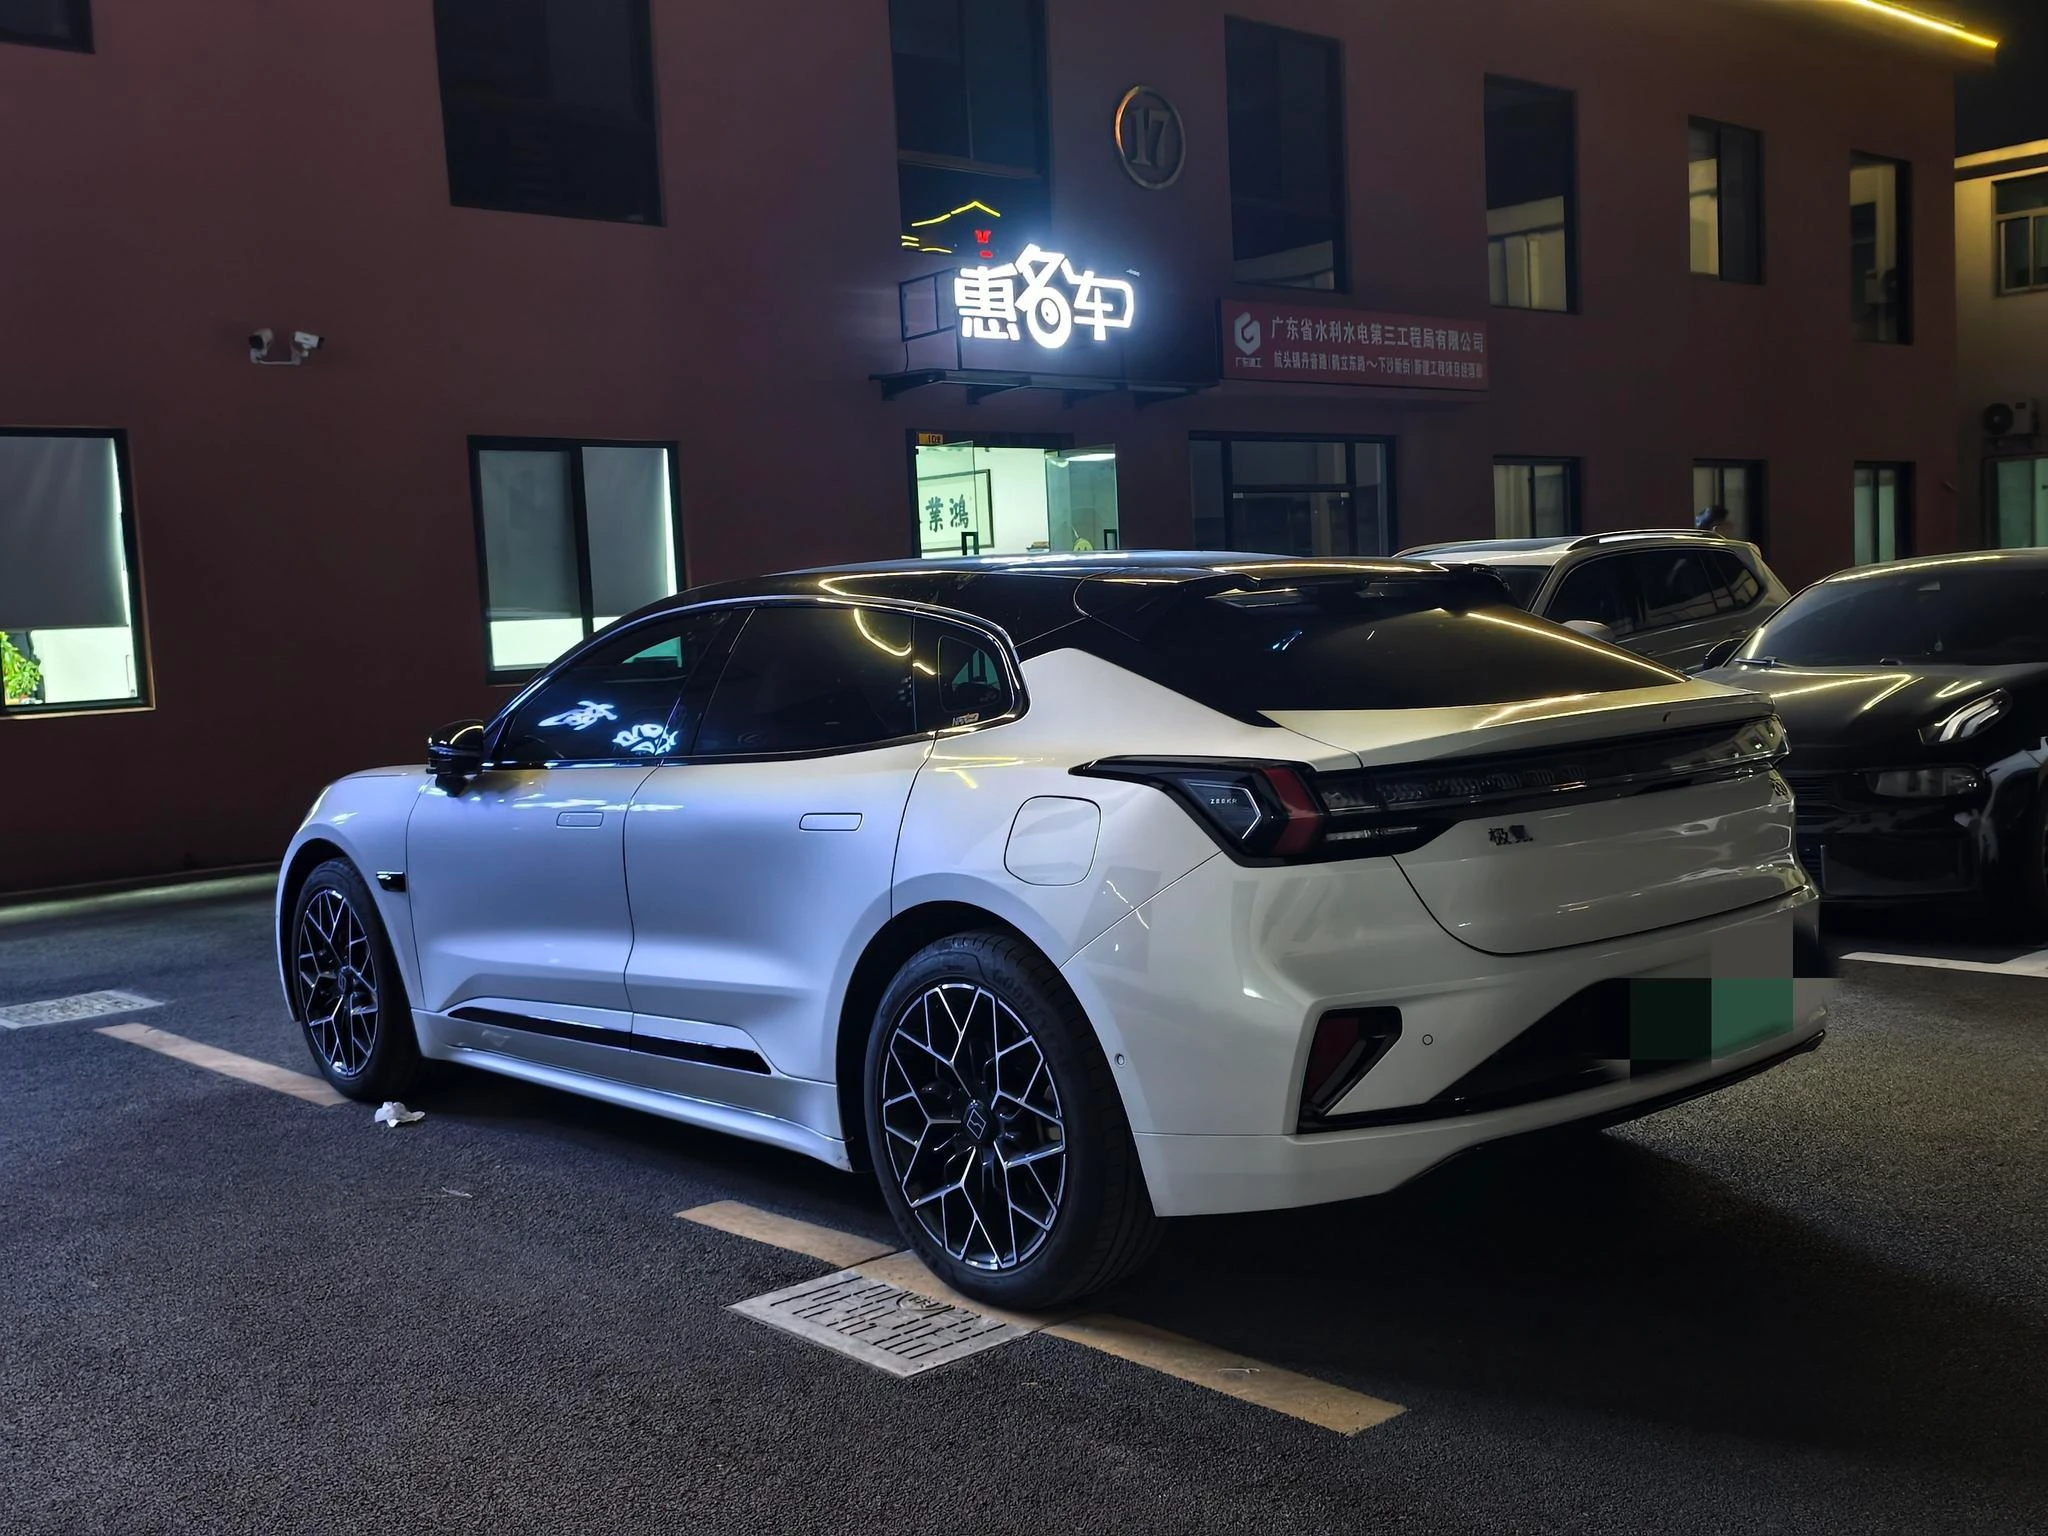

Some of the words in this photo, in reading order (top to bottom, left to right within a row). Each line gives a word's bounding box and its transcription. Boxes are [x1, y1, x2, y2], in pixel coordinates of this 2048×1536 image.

[1130, 107, 1171, 168] 17
[1271, 315, 1484, 353] 广东省水利水电第三工程局有限公司
